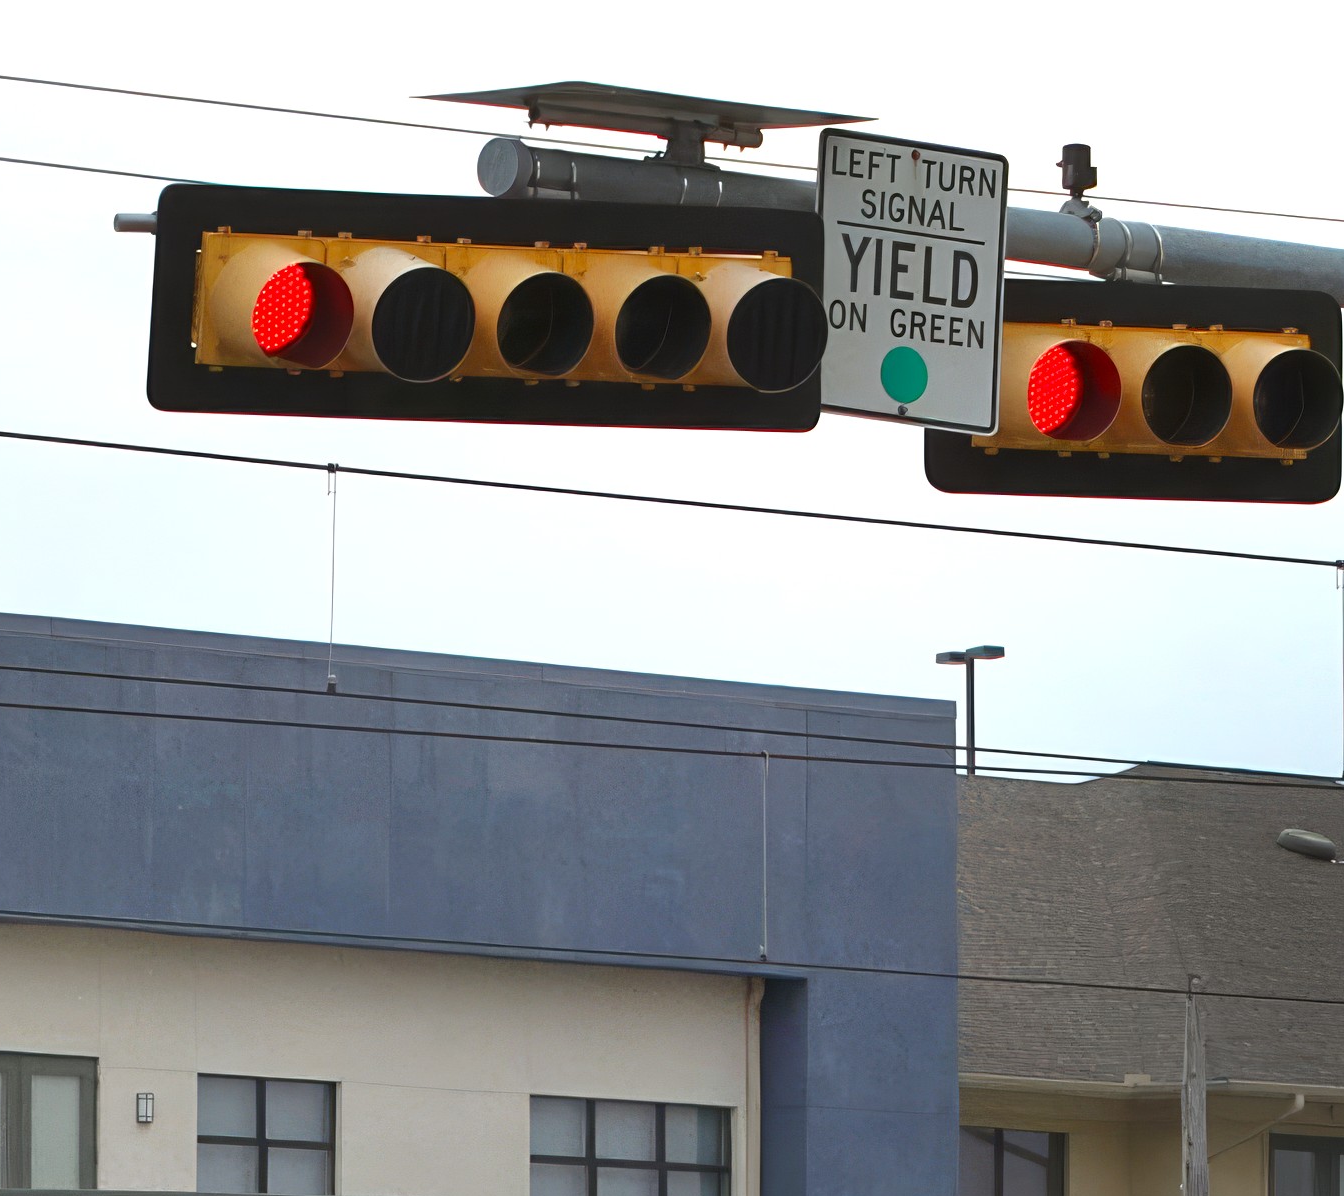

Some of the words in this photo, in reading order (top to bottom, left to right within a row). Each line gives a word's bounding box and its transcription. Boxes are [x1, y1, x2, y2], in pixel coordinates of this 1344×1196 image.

[831, 145, 902, 183] LEFT
[922, 159, 997, 199] TURN
[860, 189, 965, 231] SIGNAL
[841, 233, 979, 309] YIELD
[828, 299, 868, 333] ON
[890, 308, 985, 349] GREEN
